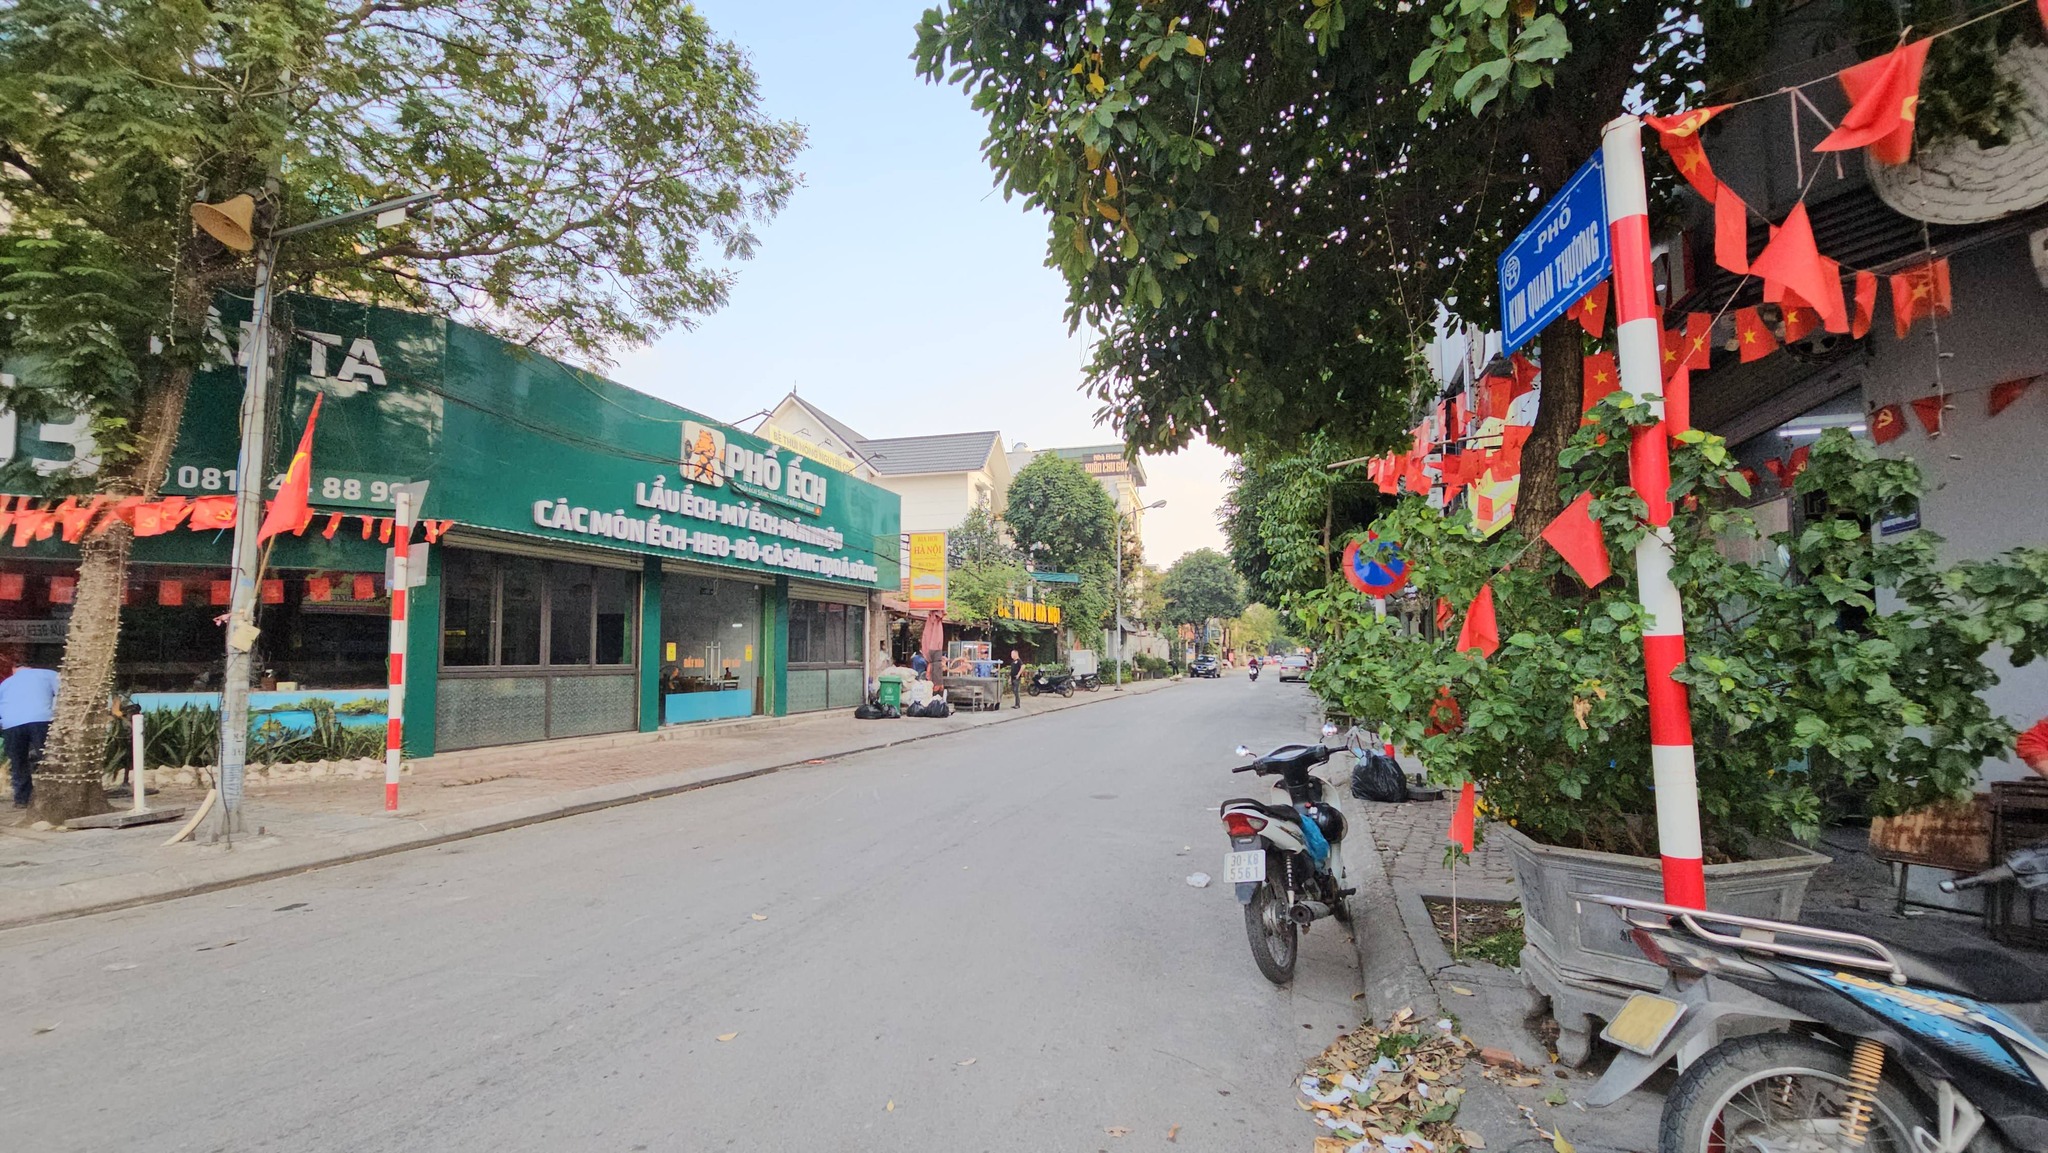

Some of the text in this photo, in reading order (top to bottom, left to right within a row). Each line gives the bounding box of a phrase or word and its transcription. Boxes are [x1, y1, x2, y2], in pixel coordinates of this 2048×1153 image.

[1538, 195, 1571, 254] PHỐ
[1508, 220, 1600, 333] KIM QUAN THƯỢNG
[322, 476, 362, 500] 88
[725, 443, 782, 491] PHỐ
[786, 455, 827, 507] ẾCH
[534, 497, 589, 533] CÁC
[589, 508, 645, 544] MÓN
[914, 543, 941, 557] HÀ NỘI
[1230, 866, 1258, 880] 5561
